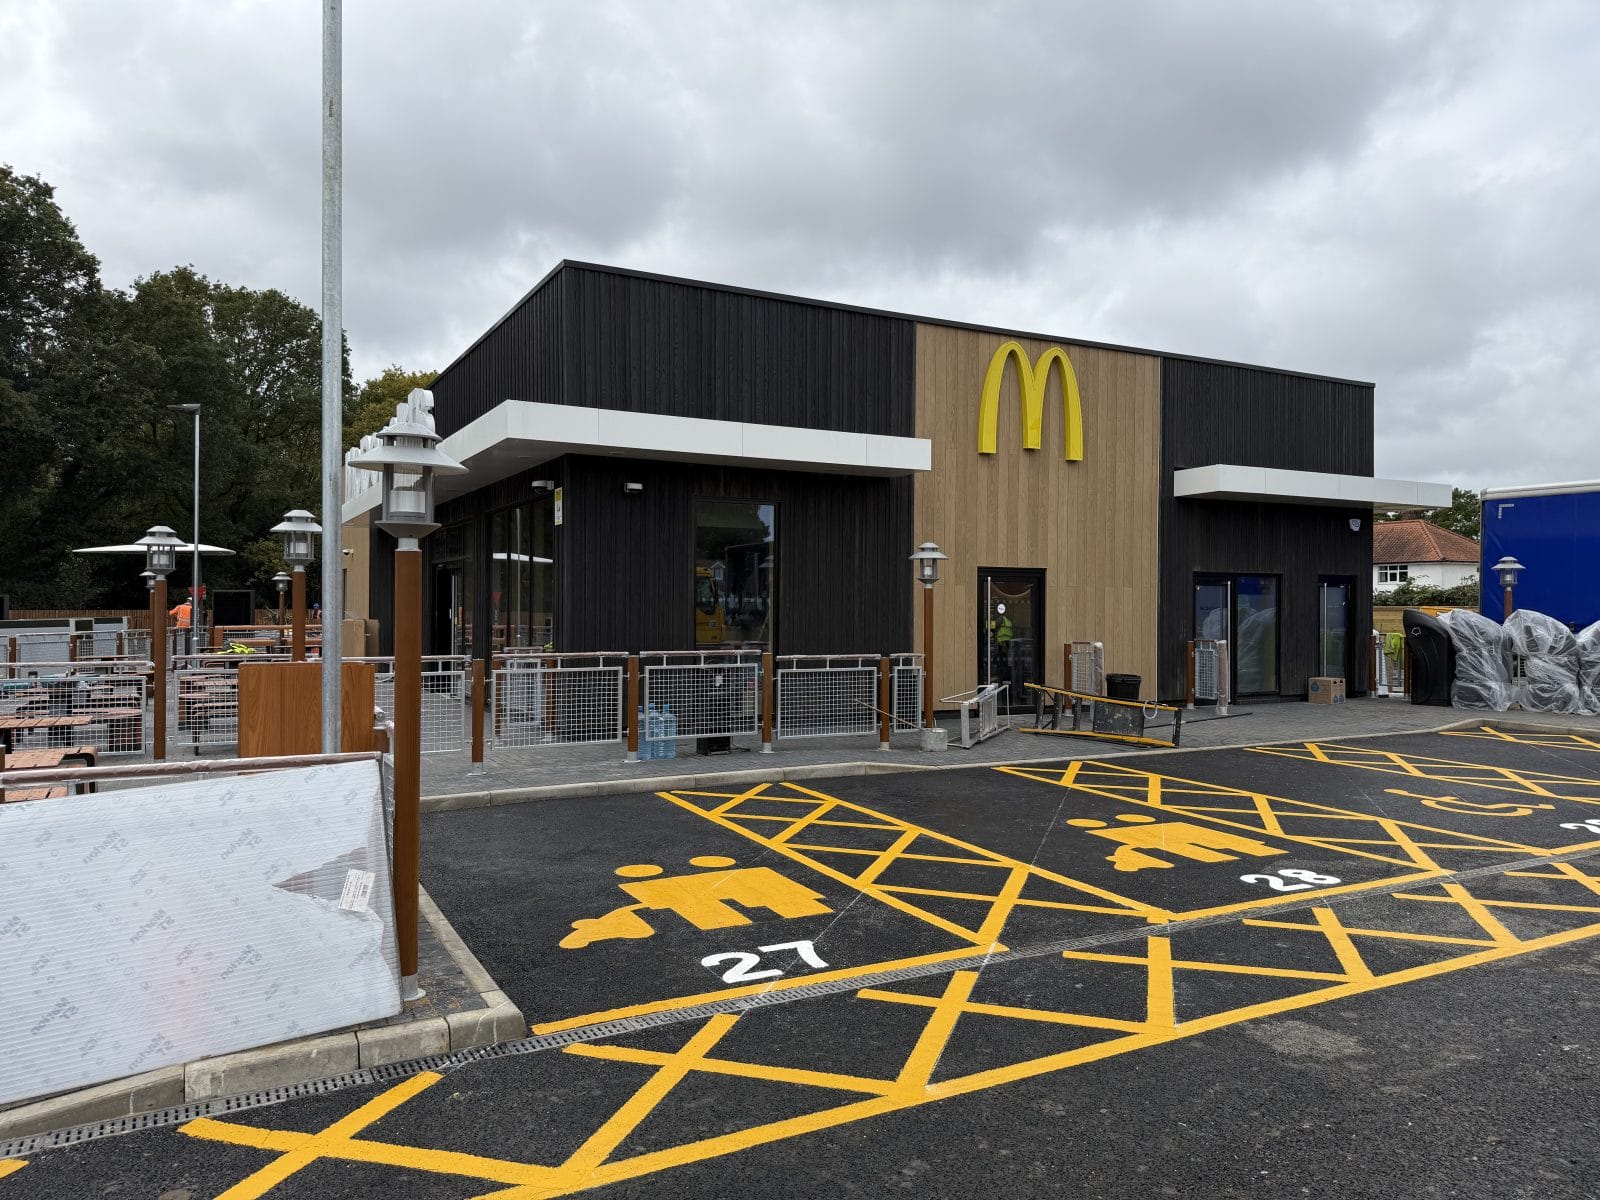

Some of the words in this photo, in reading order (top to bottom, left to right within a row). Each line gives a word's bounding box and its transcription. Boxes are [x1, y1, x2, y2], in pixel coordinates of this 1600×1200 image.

[978, 341, 1083, 461] M
[1559, 819, 1600, 834] 2
[1239, 868, 1341, 891] 28
[701, 940, 829, 984] 27
